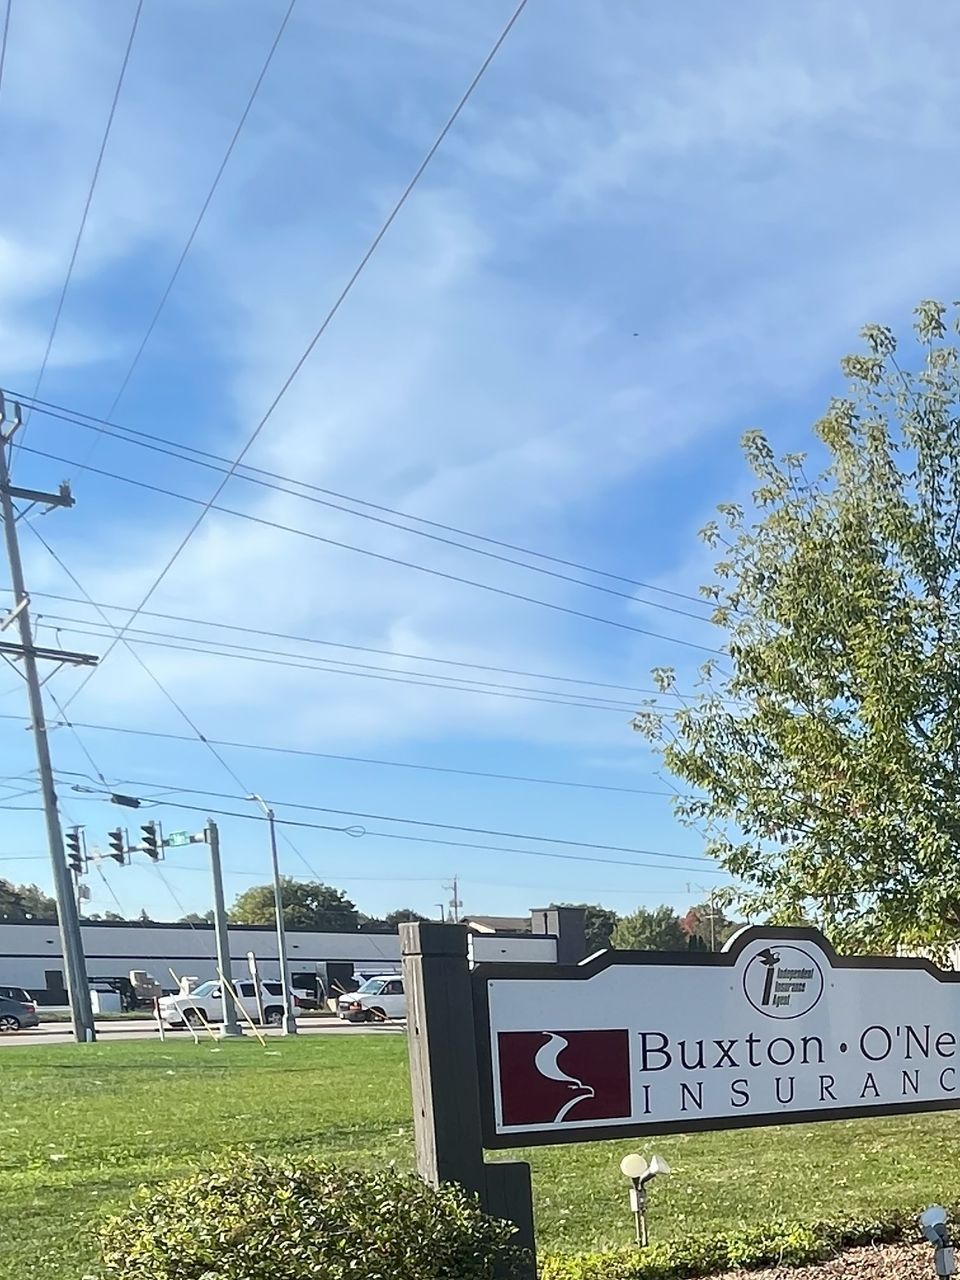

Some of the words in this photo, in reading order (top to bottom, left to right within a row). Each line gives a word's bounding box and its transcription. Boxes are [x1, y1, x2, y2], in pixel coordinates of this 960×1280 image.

[777, 967, 814, 981] Independent
[775, 981, 806, 992] Insurance
[772, 994, 790, 1007] Agent
[638, 1031, 825, 1072] Buxton
